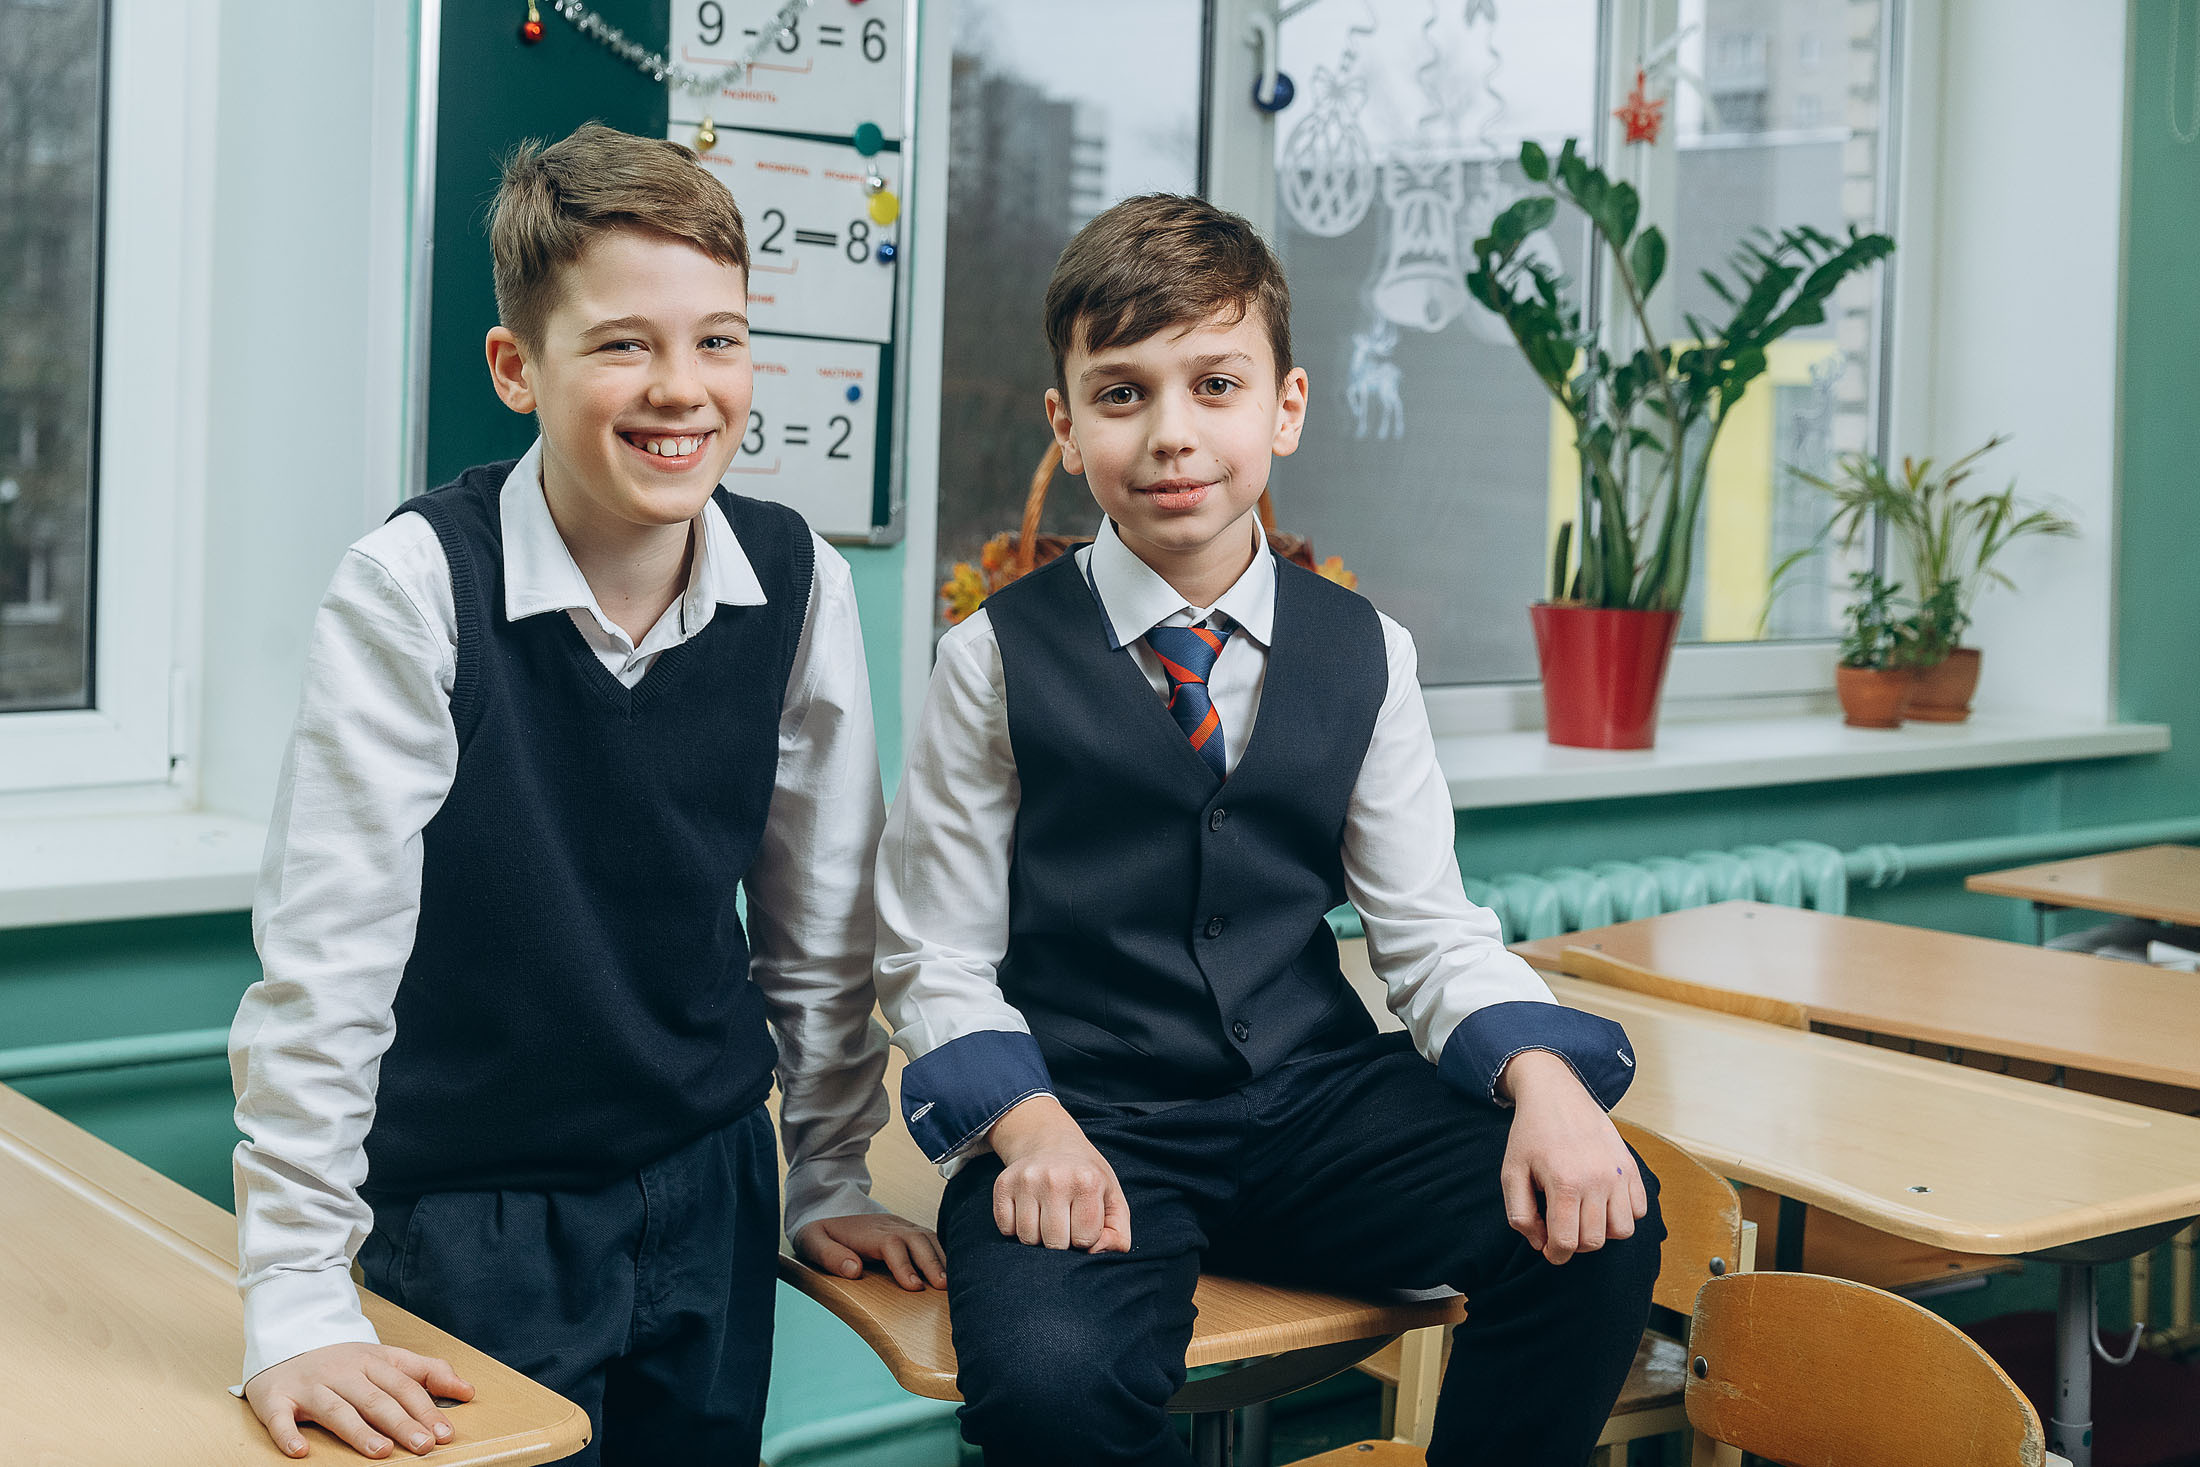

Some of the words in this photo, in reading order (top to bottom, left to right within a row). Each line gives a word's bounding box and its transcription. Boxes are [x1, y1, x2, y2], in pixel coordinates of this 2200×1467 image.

[698, 0, 724, 46] 9
[863, 18, 886, 63] 6
[741, 410, 764, 455] 3
[827, 415, 851, 459] 2
